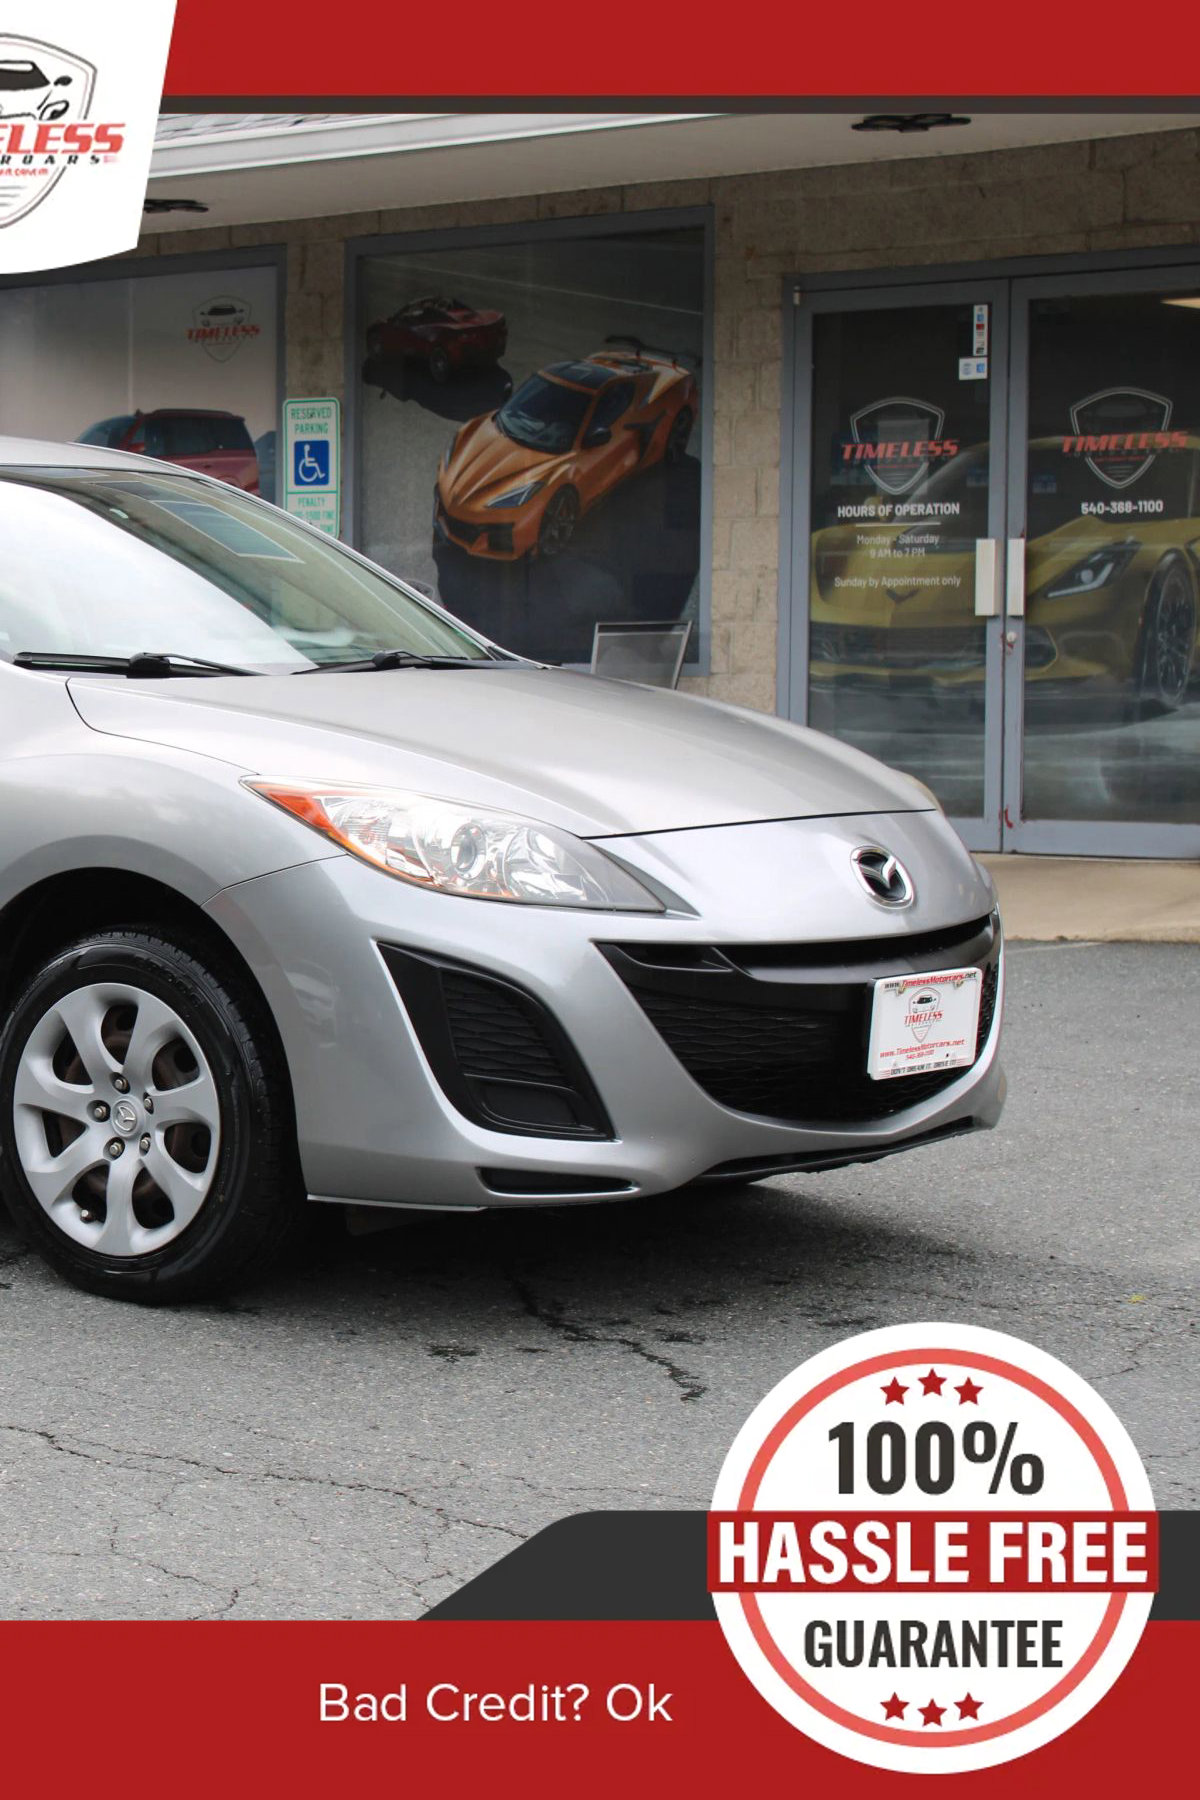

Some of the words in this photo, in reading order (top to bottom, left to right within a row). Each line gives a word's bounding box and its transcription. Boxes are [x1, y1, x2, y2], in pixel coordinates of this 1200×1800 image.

[290, 406, 332, 420] RESERVED
[294, 422, 329, 435] PARKING
[1063, 432, 1187, 452] TIMELESS
[842, 439, 959, 460] TIMELESS
[837, 504, 876, 518] HOURS
[878, 504, 893, 517] OF
[895, 502, 960, 516] OPERATION
[1081, 500, 1163, 515] 540-368-1100
[856, 534, 891, 546] Monday
[898, 533, 940, 546] Saturday
[878, 549, 891, 558] AM
[893, 548, 902, 558] to
[911, 547, 925, 557] PM
[834, 577, 866, 589] Sunday
[868, 576, 879, 588] by
[881, 576, 940, 588] Appointment
[941, 576, 961, 588] only
[904, 1011, 943, 1024] TIMELESS
